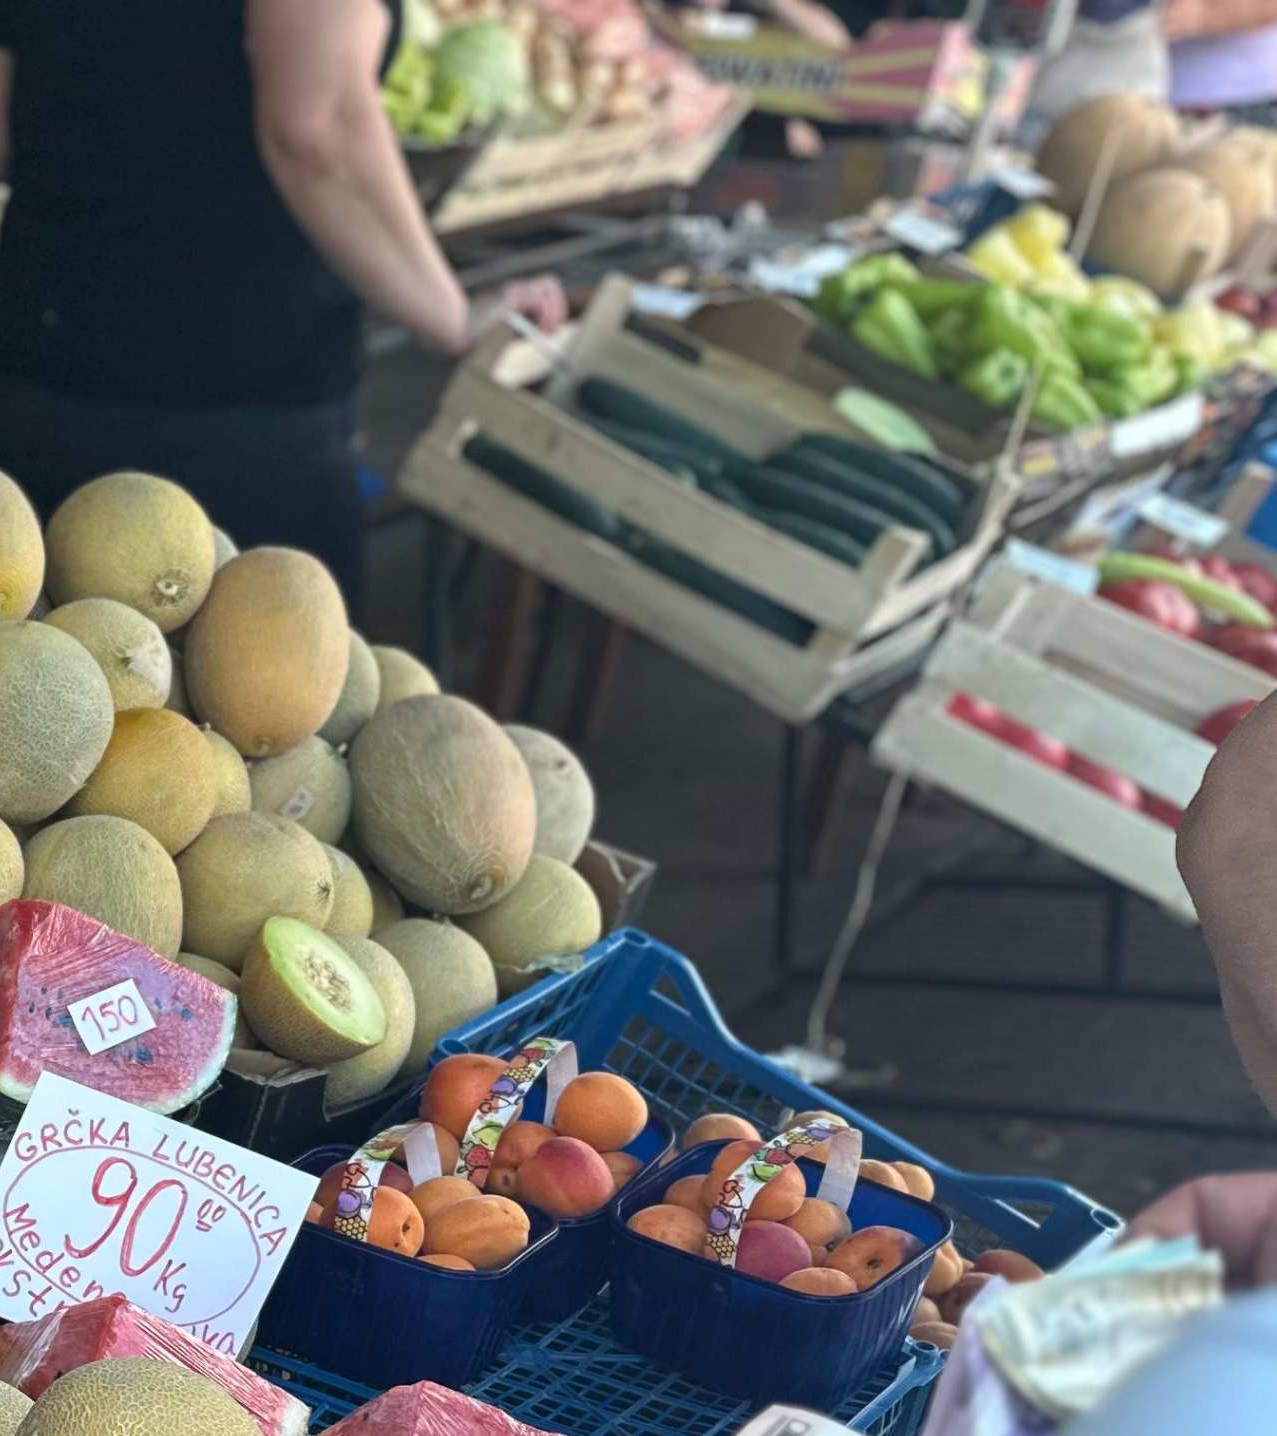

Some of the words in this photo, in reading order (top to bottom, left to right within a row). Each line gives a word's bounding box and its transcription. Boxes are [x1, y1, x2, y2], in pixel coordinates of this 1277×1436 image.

[81, 995, 138, 1041] 150
[14, 1108, 132, 1161] GRČKA
[152, 1134, 288, 1256] LUBENICA
[64, 1157, 188, 1276] 90
[5, 1203, 126, 1302] Meden
[153, 1260, 187, 1313] Kg
